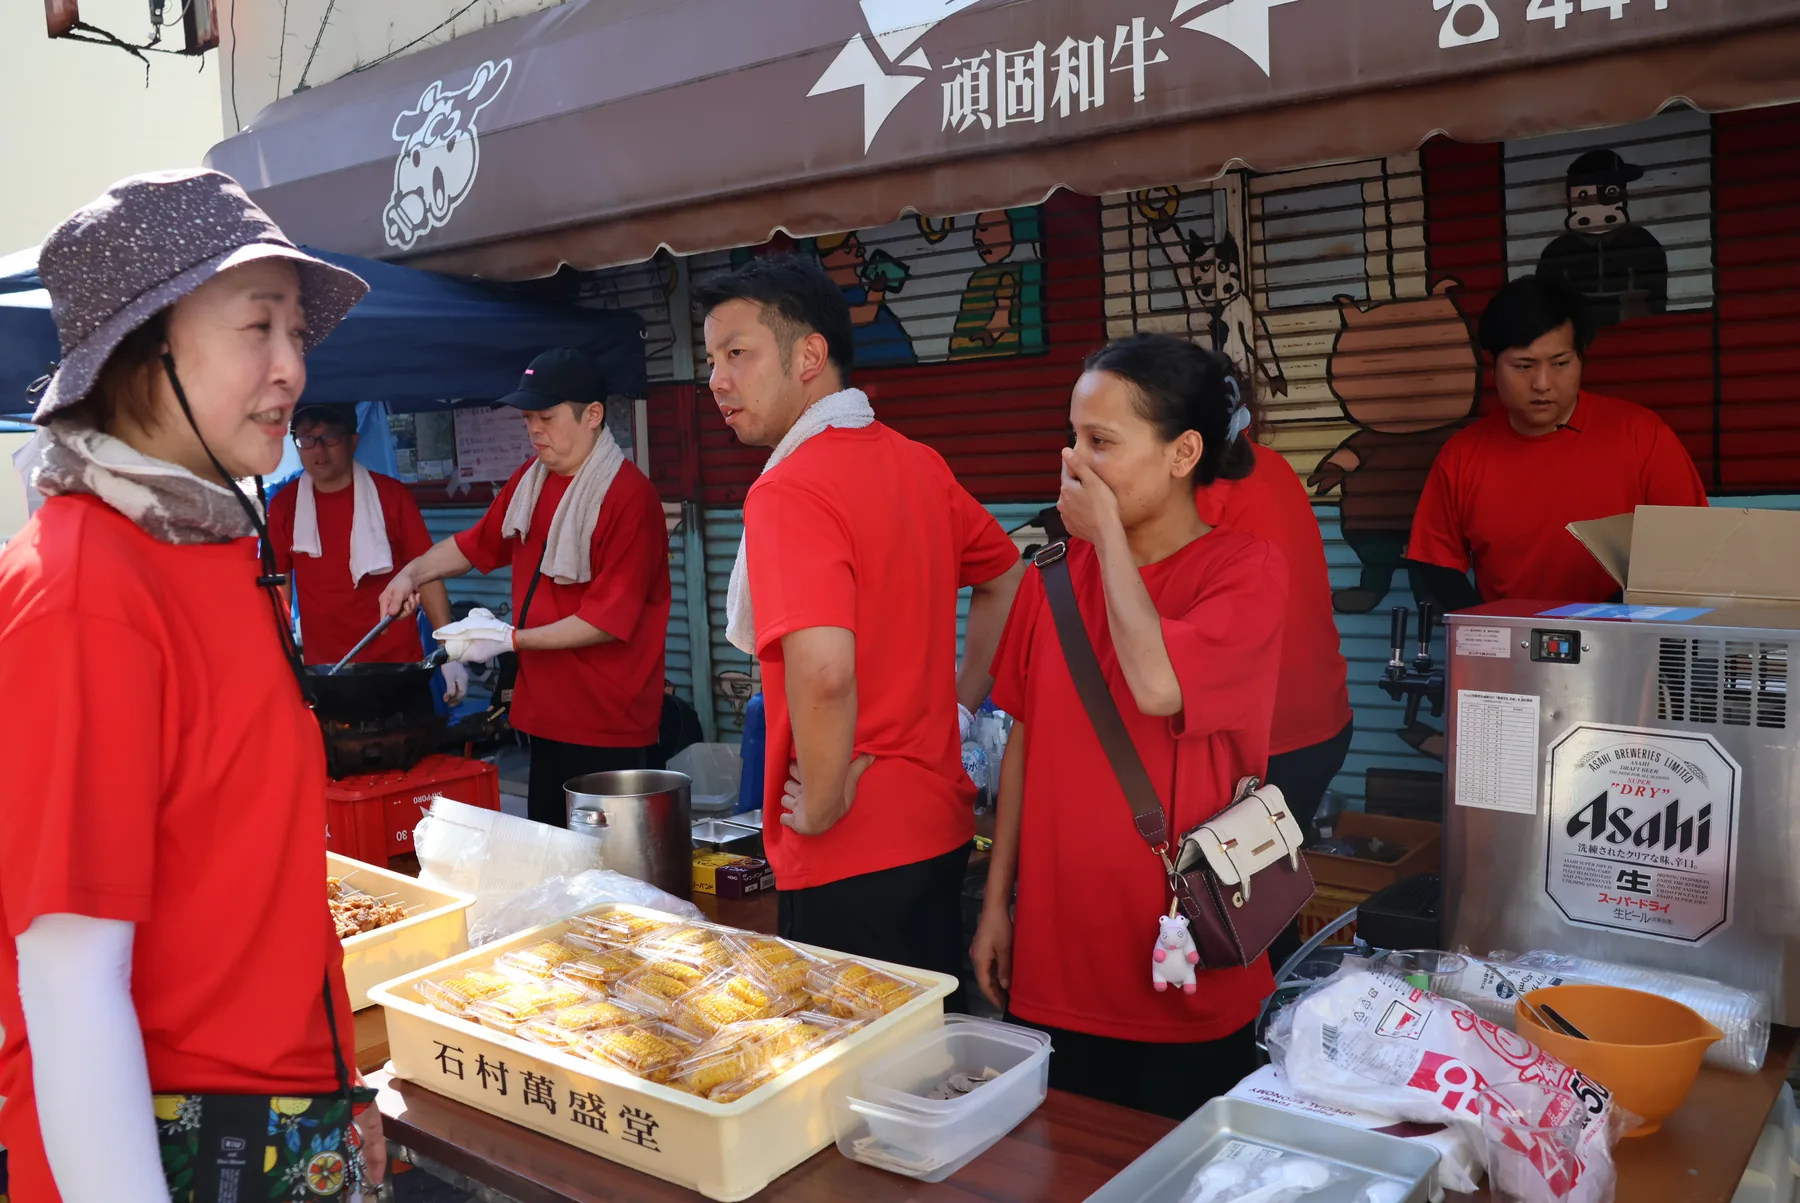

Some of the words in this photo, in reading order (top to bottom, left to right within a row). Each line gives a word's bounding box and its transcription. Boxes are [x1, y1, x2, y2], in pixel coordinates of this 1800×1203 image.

[941, 16, 1169, 134] 頑固和牛
[1588, 753, 1612, 772] ASAHI
[1614, 748, 1662, 763] BREWERIES
[1663, 757, 1694, 784] LIMITED
[1566, 790, 1712, 856] Asahi
[1616, 869, 1651, 895] 生
[1598, 893, 1670, 913] スーパードライ
[433, 1040, 661, 1152] 石村萬盛堂
[1248, 1087, 1304, 1105] ECONOMY
